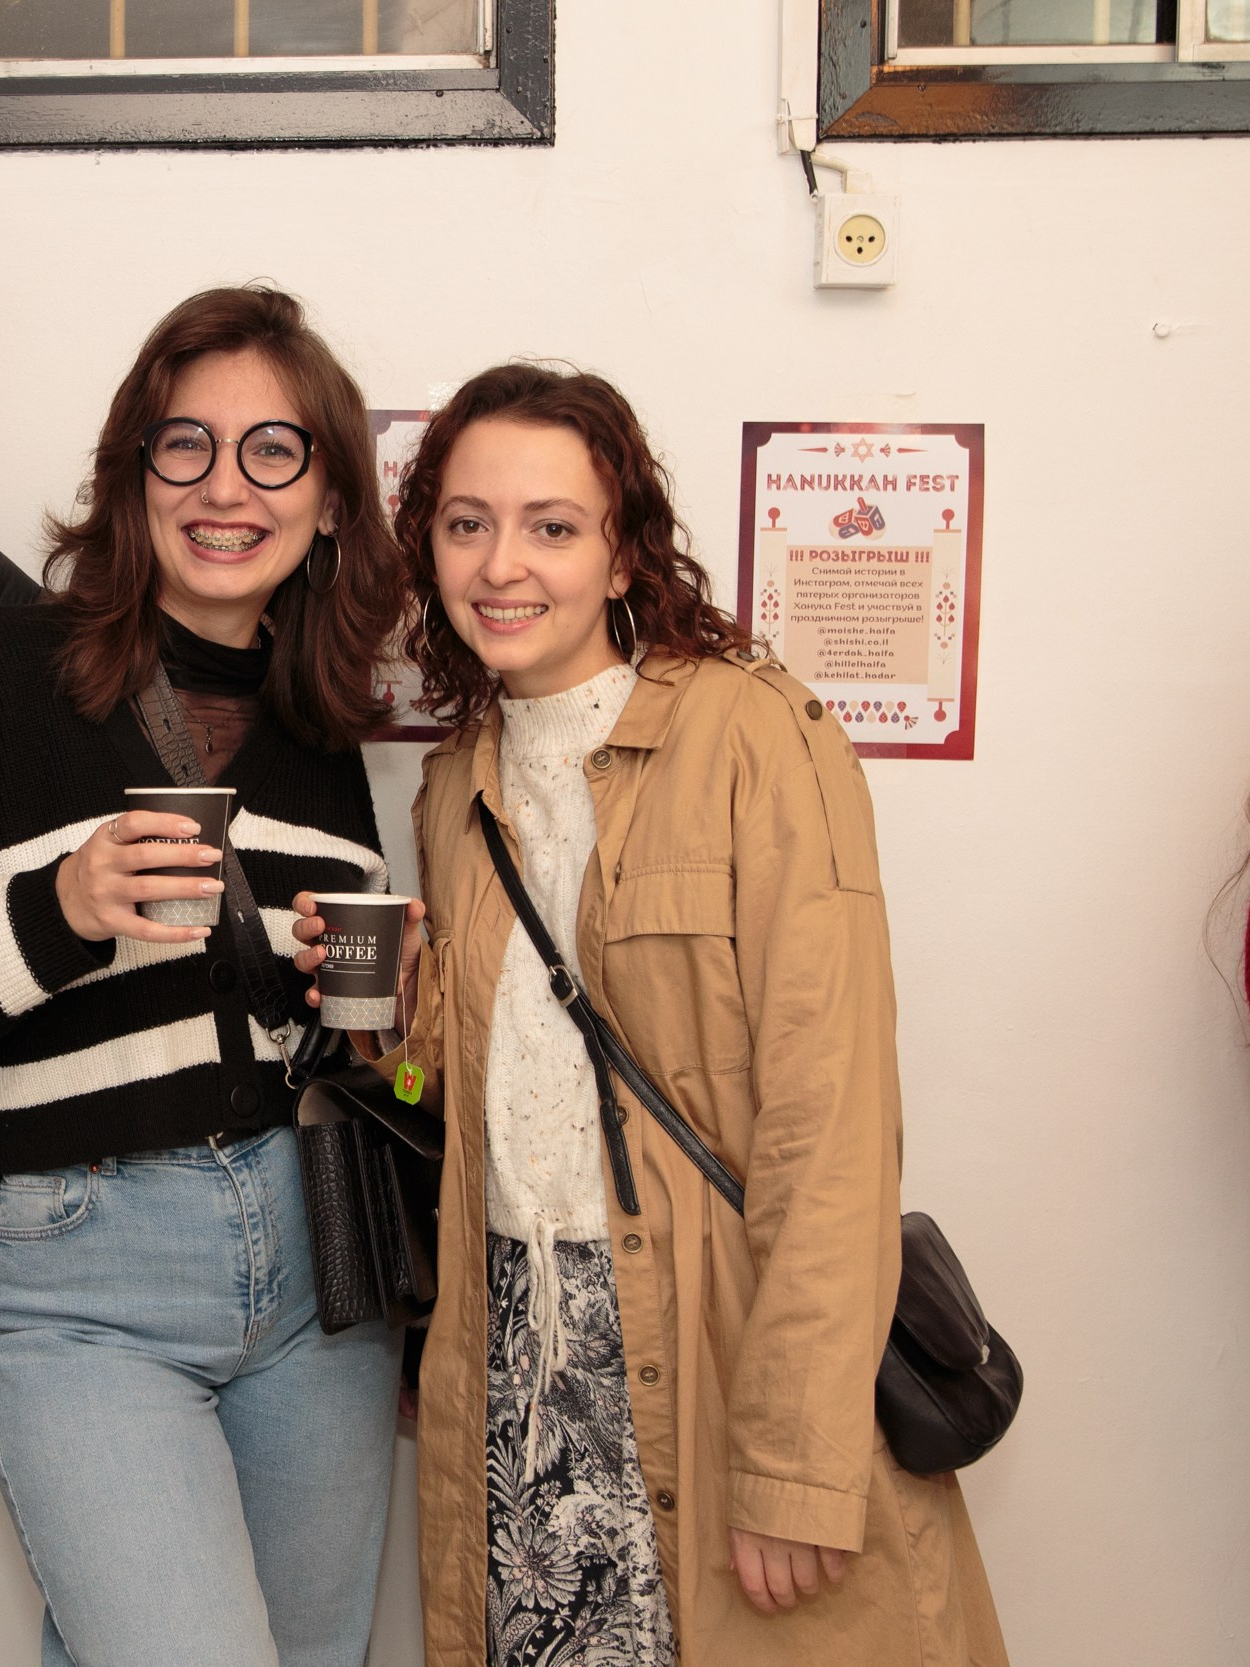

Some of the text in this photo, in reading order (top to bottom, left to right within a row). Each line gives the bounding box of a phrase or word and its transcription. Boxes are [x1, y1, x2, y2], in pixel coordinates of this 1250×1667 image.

[766, 473, 960, 492] HANUKKAH FEST
[809, 550, 910, 563] РОЗЫГРЫШ
[812, 567, 852, 576] Снимай
[854, 569, 897, 577] истории
[793, 579, 852, 589] Инстаграм,
[854, 580, 898, 588] отмечай
[796, 591, 920, 601] пятерых организаторов
[793, 602, 831, 611] Ханука
[834, 602, 856, 611] Fest
[858, 603, 865, 611] и
[867, 603, 914, 613] участвуй
[790, 614, 925, 624] праздничном розыгрыше!
[817, 626, 896, 636] @moishe_haifa
[823, 638, 889, 647] @shishi.co.il
[816, 649, 894, 658] @4erdak_haifa
[824, 660, 886, 670] @hillelhaifa
[813, 671, 897, 680] @kehilat_hadar
[321, 944, 377, 960] OFFEE
